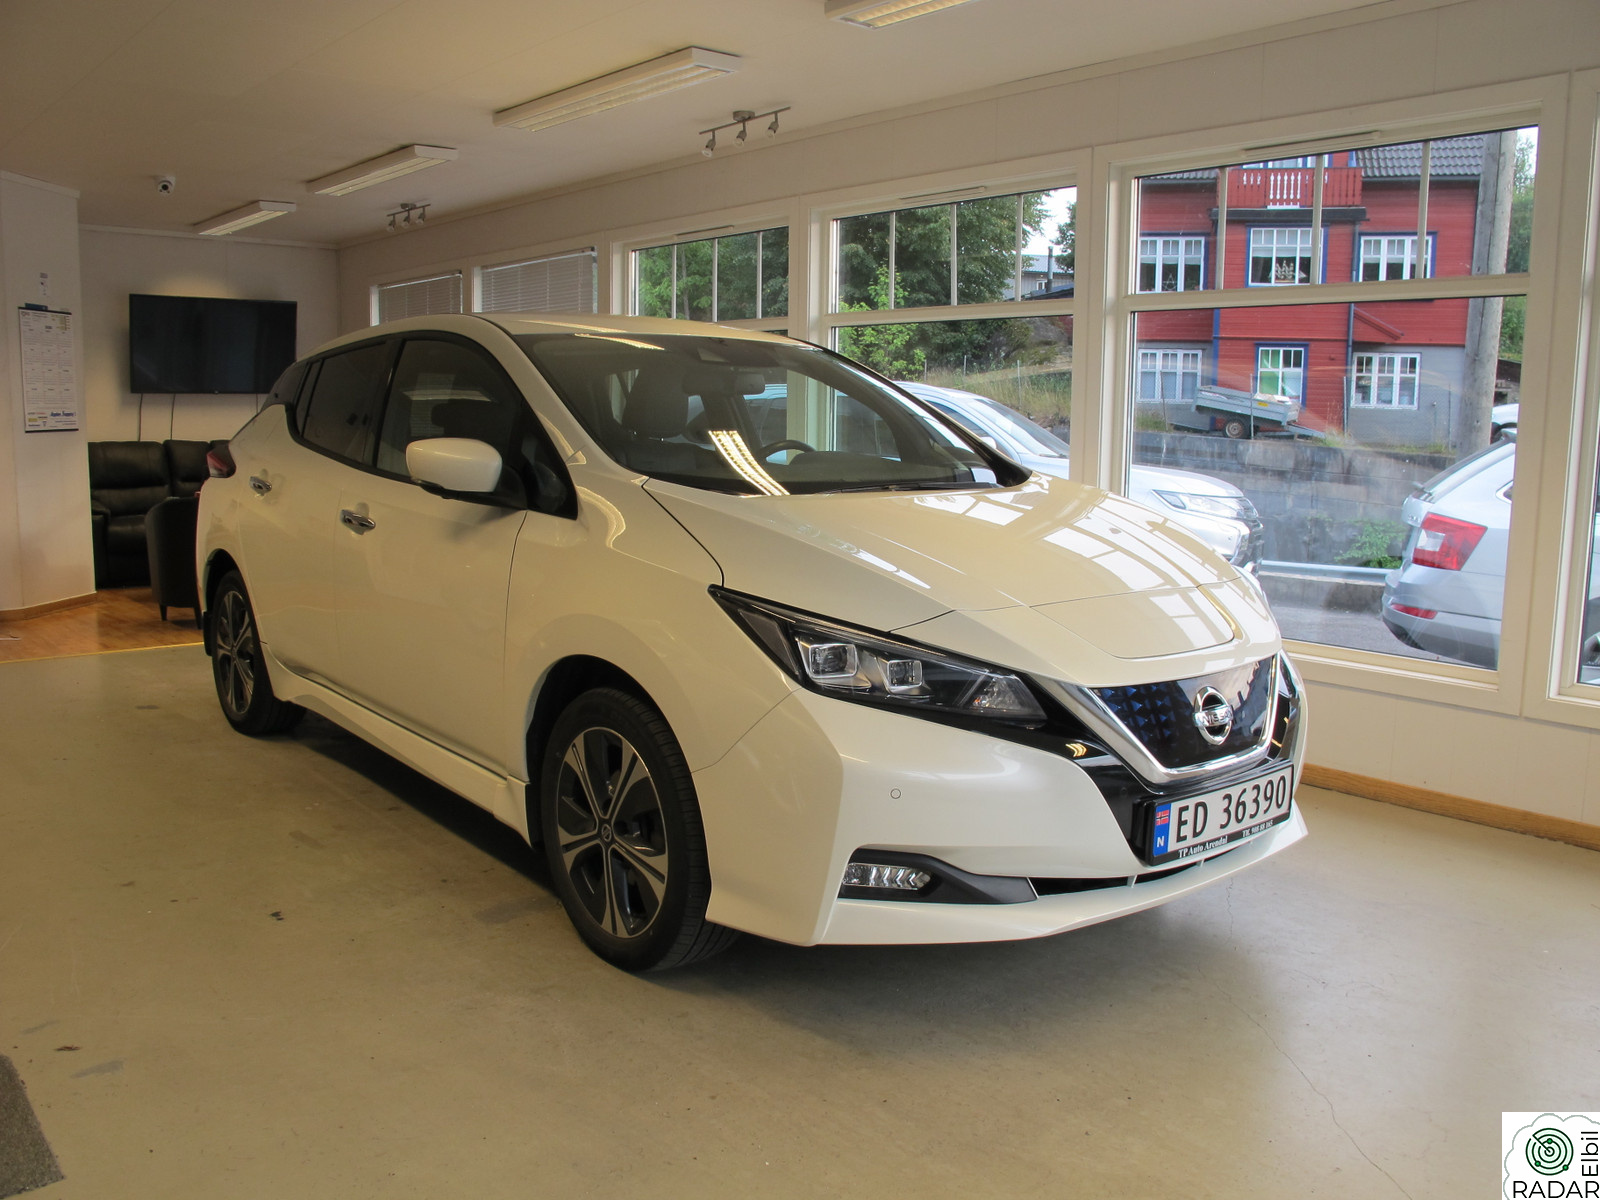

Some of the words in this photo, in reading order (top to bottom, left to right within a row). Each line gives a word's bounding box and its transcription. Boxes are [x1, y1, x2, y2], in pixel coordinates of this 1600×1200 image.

[1176, 801, 1208, 843] ED
[1220, 775, 1286, 829] 36390
[1156, 835, 1165, 848] N
[1188, 845, 1204, 855] Auto
[1204, 835, 1228, 850] Arendal
